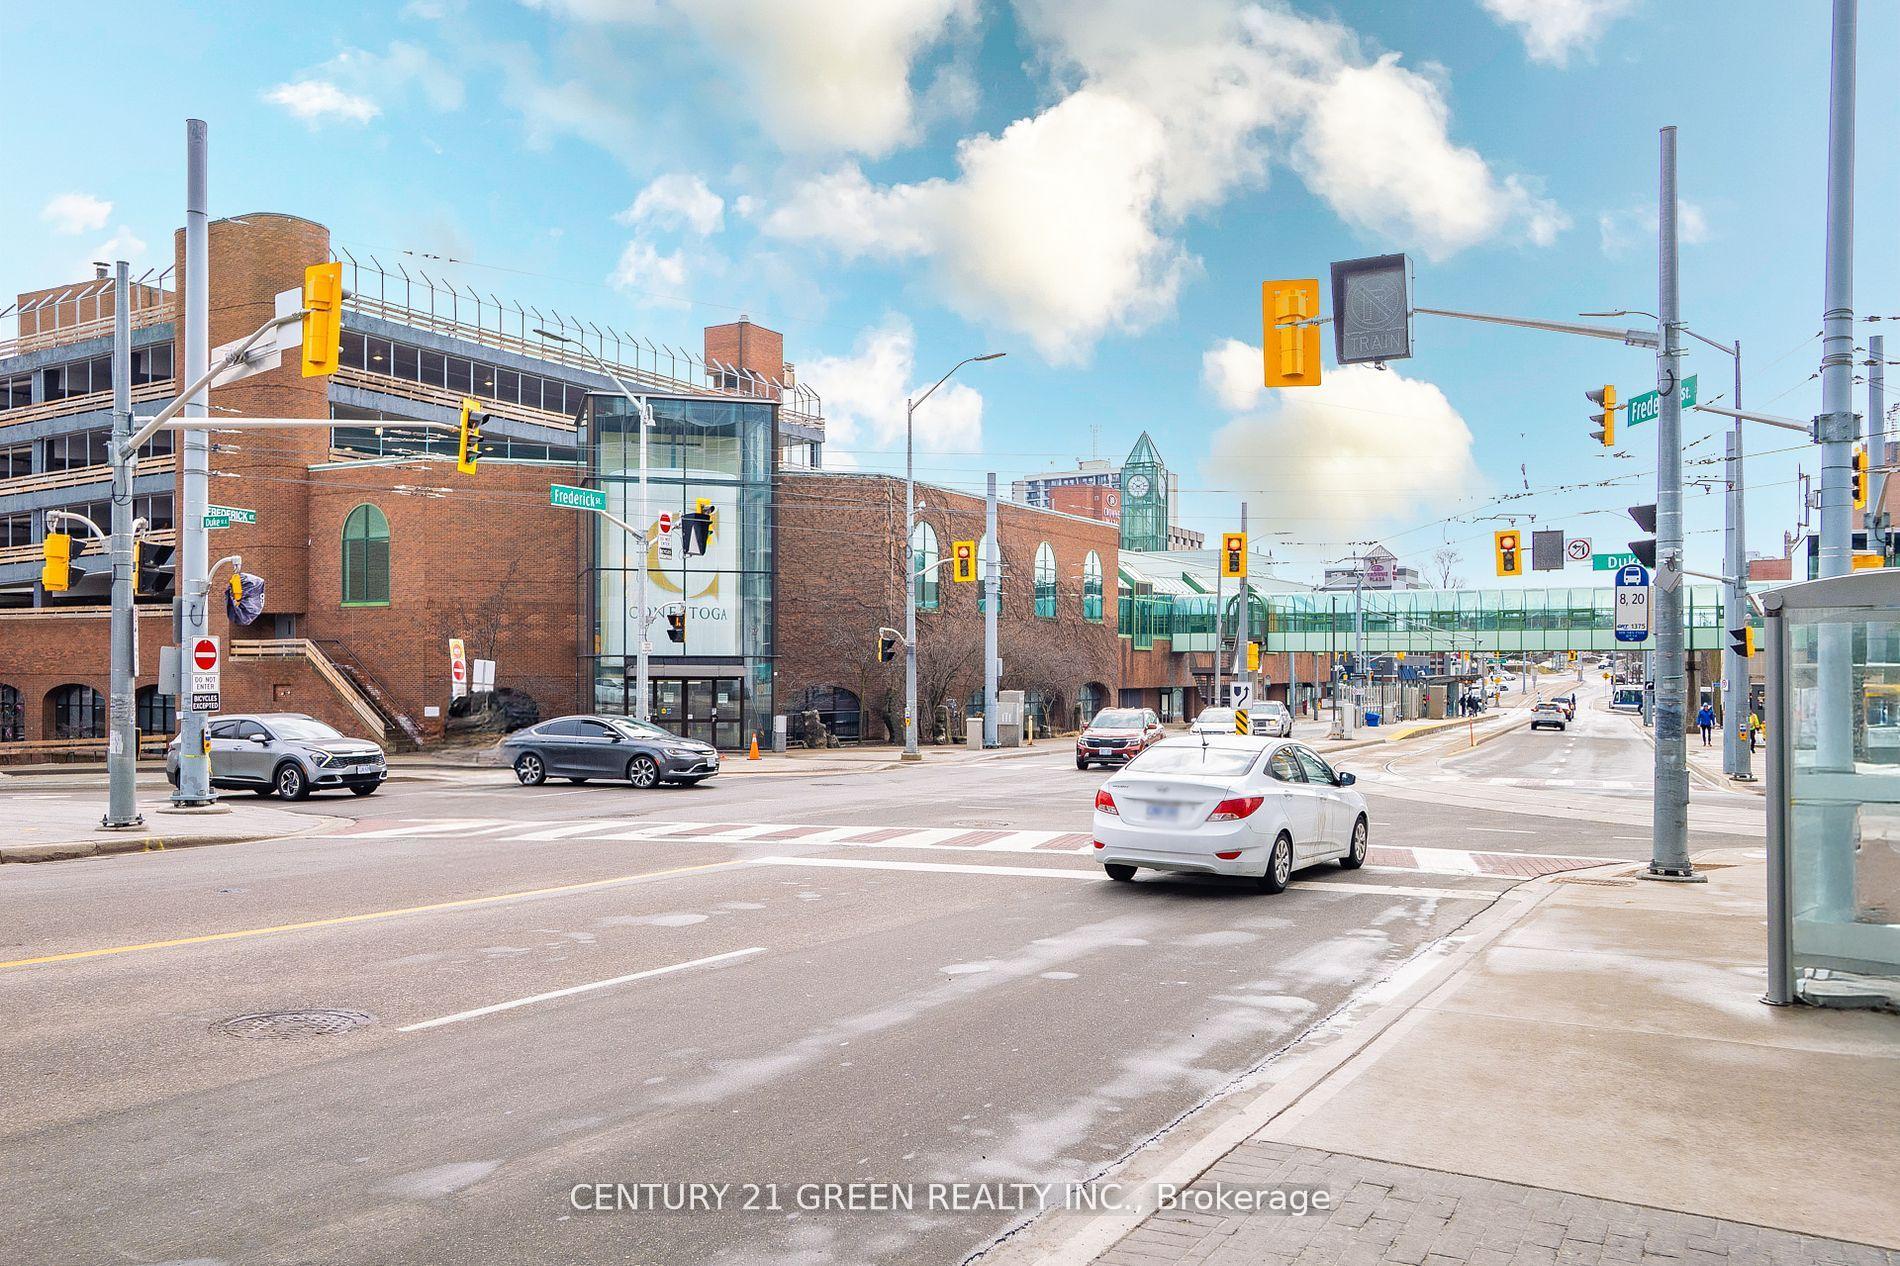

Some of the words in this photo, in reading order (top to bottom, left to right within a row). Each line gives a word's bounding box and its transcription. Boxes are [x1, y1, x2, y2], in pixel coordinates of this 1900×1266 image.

[1351, 332, 1402, 352] TRAIN
[1631, 394, 1659, 422] Frede
[554, 489, 595, 507] Frederick
[207, 507, 248, 522] FREDERICK
[205, 518, 220, 527] Duke
[1619, 593, 1629, 606] 8,
[1632, 593, 1645, 605] 20
[193, 702, 219, 710] EXCEPTED
